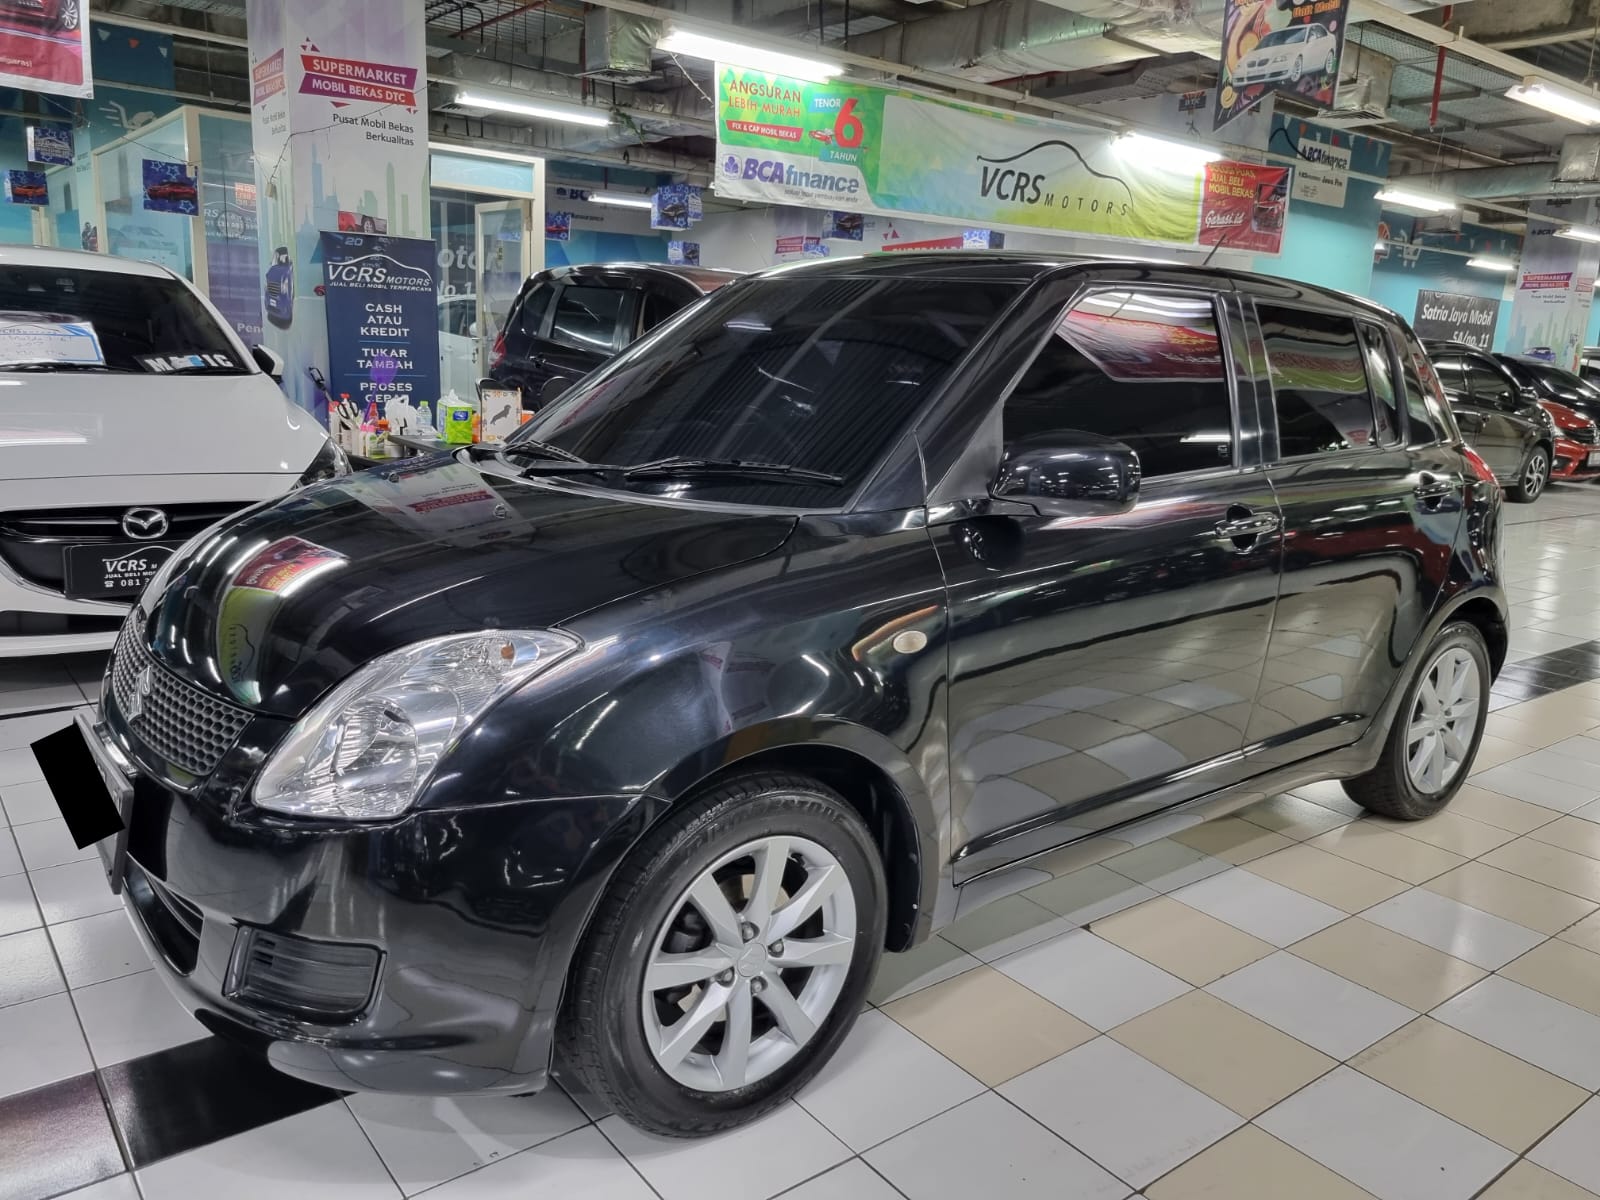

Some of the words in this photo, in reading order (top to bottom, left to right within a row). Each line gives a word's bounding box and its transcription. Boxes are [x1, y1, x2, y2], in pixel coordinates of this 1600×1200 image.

[312, 58, 407, 86] SUPERMARKET
[312, 78, 346, 94] MOBIL
[349, 84, 383, 99] BEKAS
[385, 90, 406, 103] DTC
[729, 79, 801, 103] ANGSURAN
[729, 95, 757, 111] LEBIH
[762, 102, 800, 118] MURAH
[814, 98, 841, 108] TENOR
[333, 113, 358, 126] Pusat
[361, 118, 386, 129] Mobil
[388, 122, 414, 133] Bekas
[833, 97, 864, 149] 6
[366, 131, 414, 146] Berkualitas
[748, 125, 760, 135] CAP
[760, 126, 778, 138] MOBIL
[779, 129, 797, 140] BEKAS
[829, 150, 858, 162] TAHUN
[1210, 173, 1227, 184] JUAL
[1229, 175, 1244, 186] BELI
[981, 166, 1046, 204] VCRS
[1044, 192, 1128, 216] MOTORS
[1208, 183, 1231, 195] MOBIL
[1231, 187, 1255, 199] BEKAS
[328, 264, 387, 283] VCRS
[387, 275, 431, 287] MOTORS
[365, 303, 402, 313] CASH
[1421, 304, 1448, 321] Satria
[1448, 307, 1468, 326] Jaya
[1469, 310, 1493, 326] Mobil
[367, 315, 402, 325] ATAU
[237, 322, 264, 334] Pen
[360, 327, 410, 337] KREDIT
[1478, 333, 1489, 348] 11
[361, 348, 408, 359] TUKAR
[357, 359, 413, 370] TAMBAH
[105, 559, 147, 572] VCRS
[120, 579, 140, 587] 081
